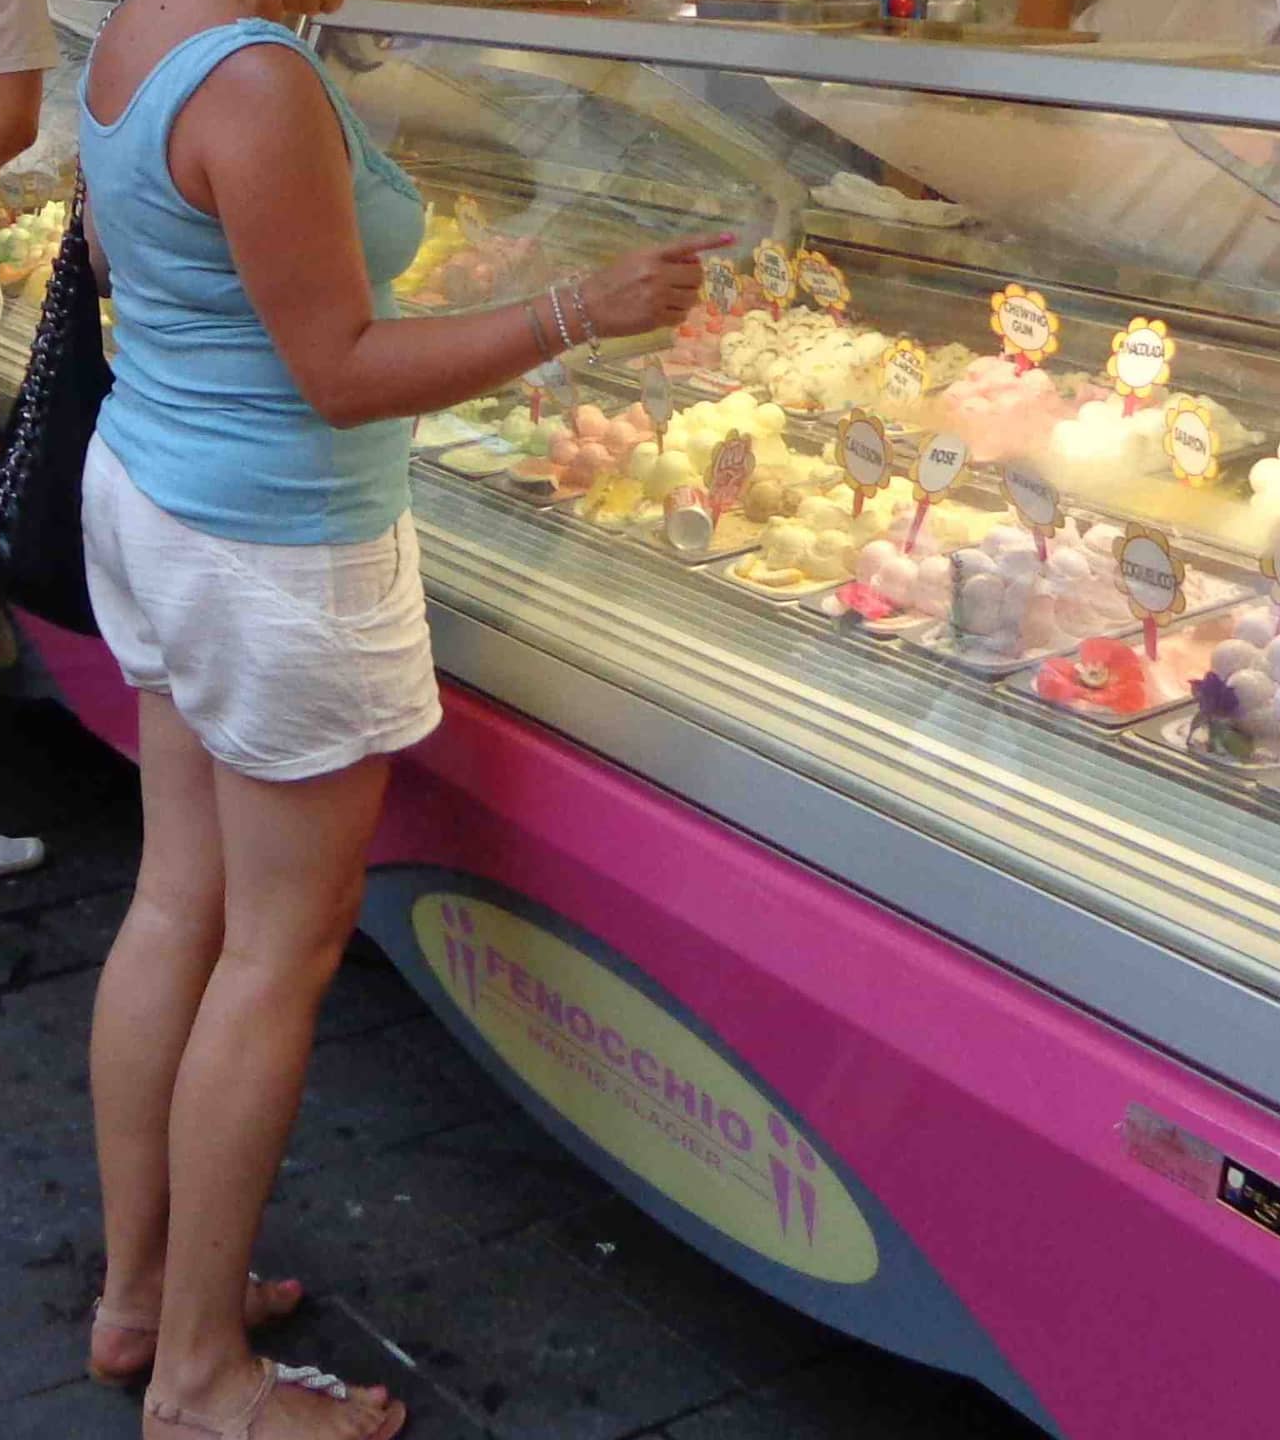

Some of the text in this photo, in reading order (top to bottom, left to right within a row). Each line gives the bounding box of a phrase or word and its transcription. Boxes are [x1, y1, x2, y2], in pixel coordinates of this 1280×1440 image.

[1004, 302, 1048, 328] CHEWING
[1012, 321, 1034, 337] GUM
[929, 448, 960, 466] ROSE
[485, 945, 753, 1152] FENOCCHIO
